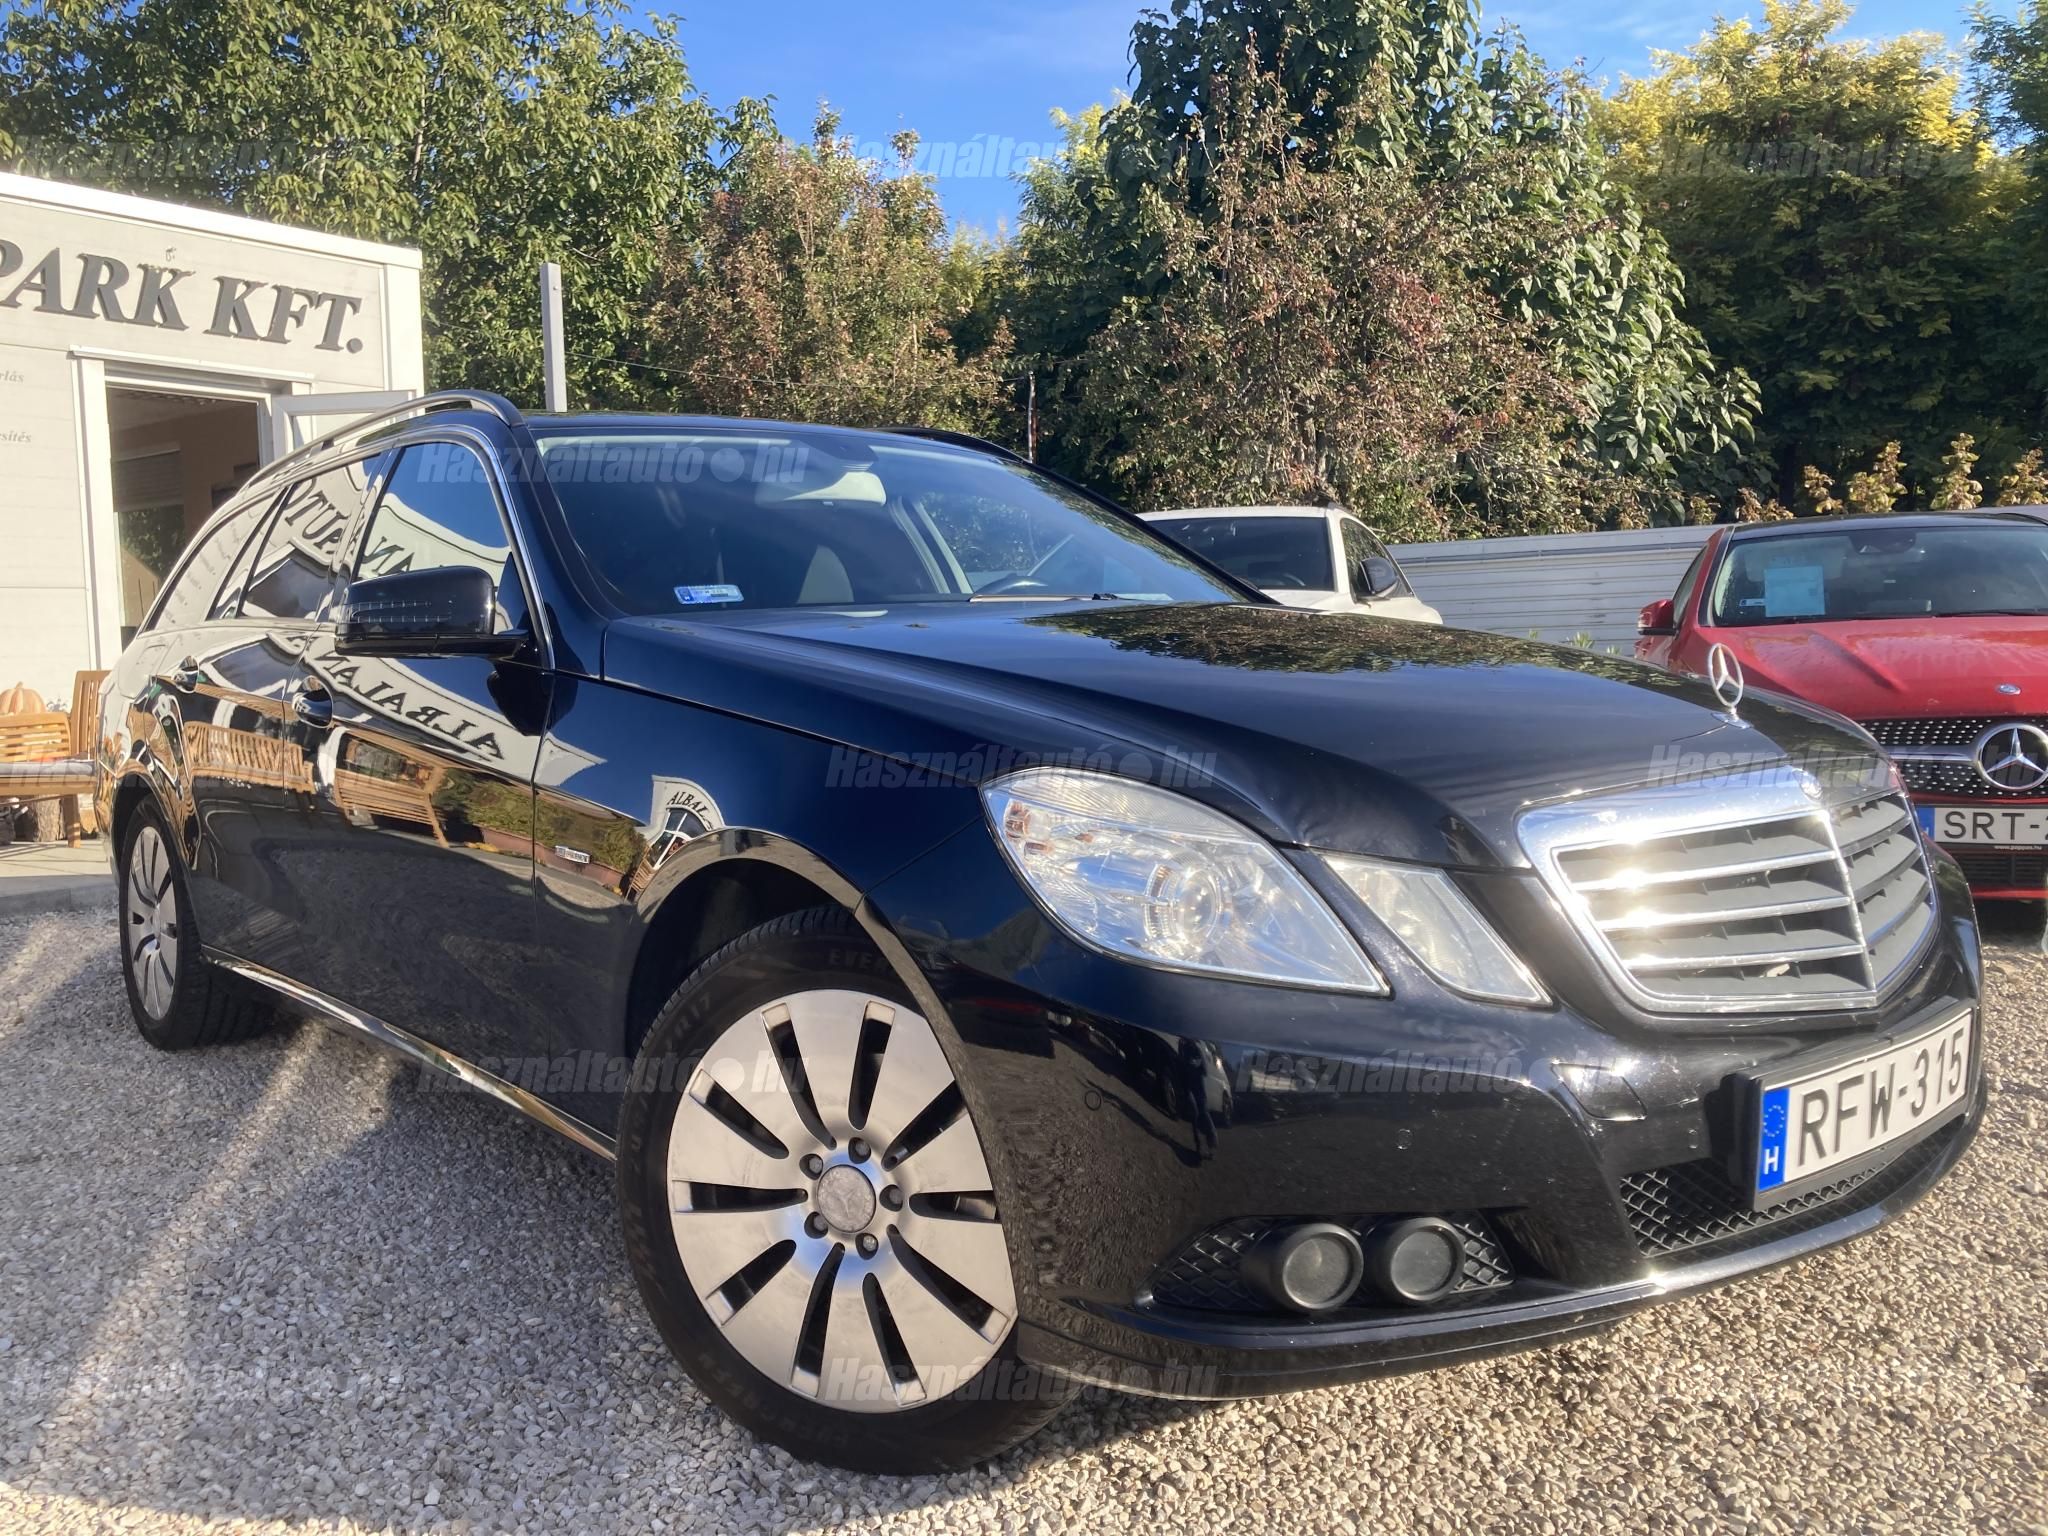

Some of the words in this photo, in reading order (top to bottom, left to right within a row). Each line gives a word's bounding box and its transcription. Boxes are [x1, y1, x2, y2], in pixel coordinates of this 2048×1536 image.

[203, 275, 363, 353] KFT.
[1944, 811, 2048, 840] SRT-
[1797, 1026, 1965, 1168] RFW-315
[1763, 1145, 1780, 1175] H
